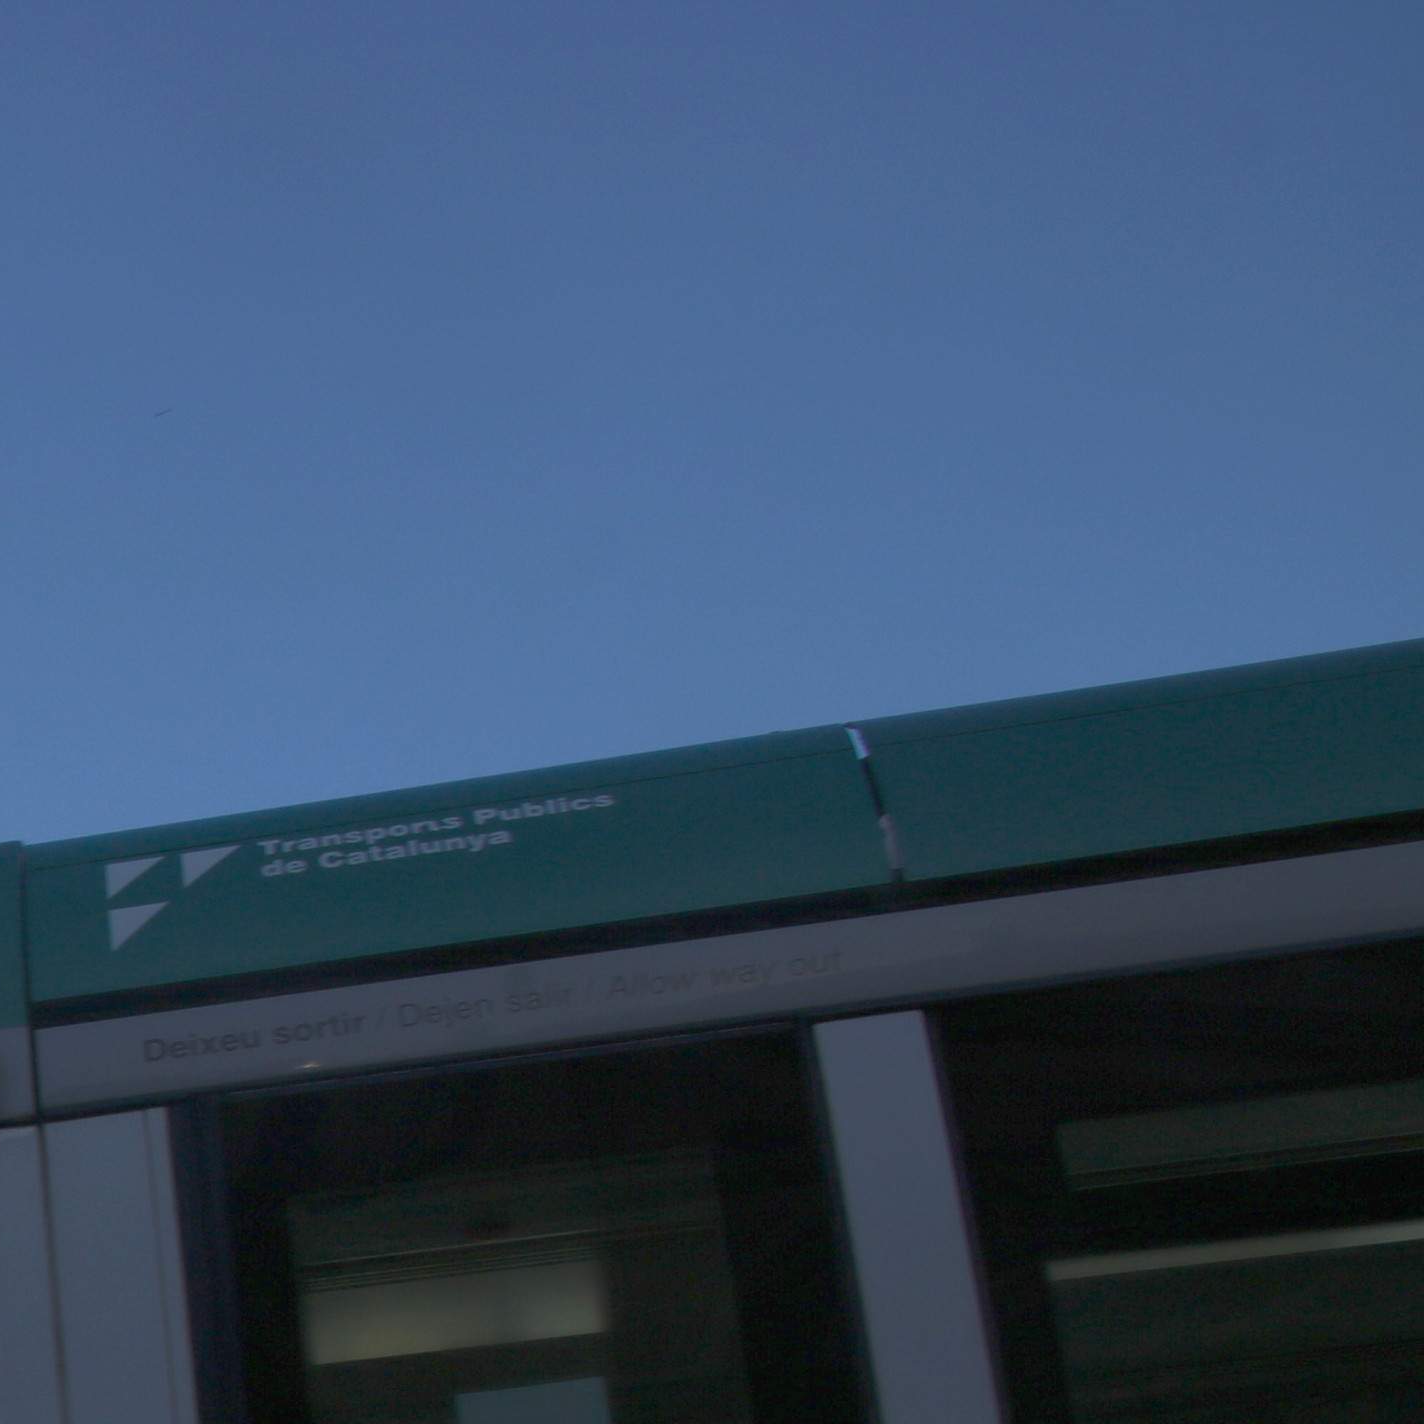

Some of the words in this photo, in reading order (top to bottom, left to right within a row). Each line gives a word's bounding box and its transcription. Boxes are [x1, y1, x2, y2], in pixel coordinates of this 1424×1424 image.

[260, 857, 308, 878] de
[319, 828, 514, 870] Catalunya
[142, 1029, 261, 1064] Deixeu
[271, 1013, 367, 1046] sortir
[399, 997, 494, 1031] Dejen
[504, 984, 575, 1017] salir
[605, 968, 694, 1002] Allow
[709, 962, 776, 990] way
[789, 950, 844, 976] out
